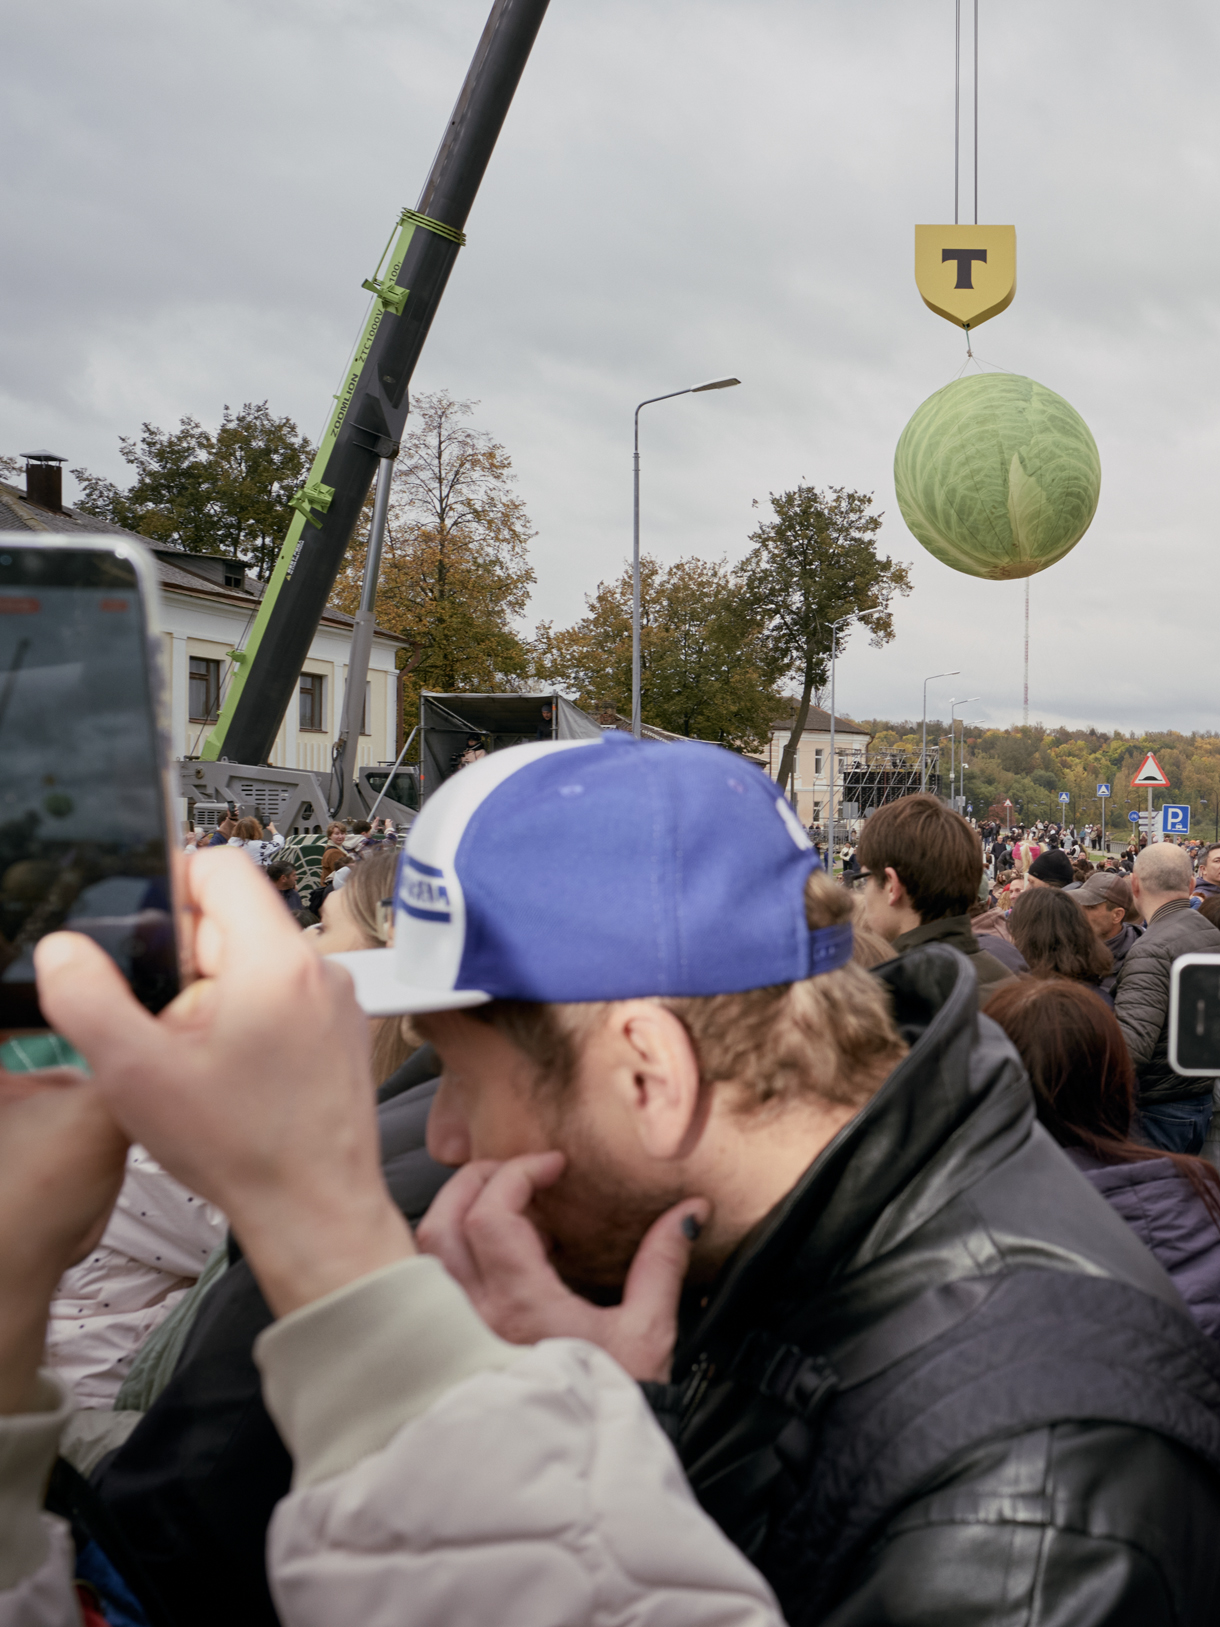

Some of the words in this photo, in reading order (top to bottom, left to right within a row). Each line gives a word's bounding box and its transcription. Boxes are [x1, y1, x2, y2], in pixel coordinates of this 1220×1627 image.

[942, 248, 987, 289] T
[330, 373, 359, 439] ZOOMLION
[358, 308, 384, 363] ZTC1000V
[1168, 808, 1184, 830] P
